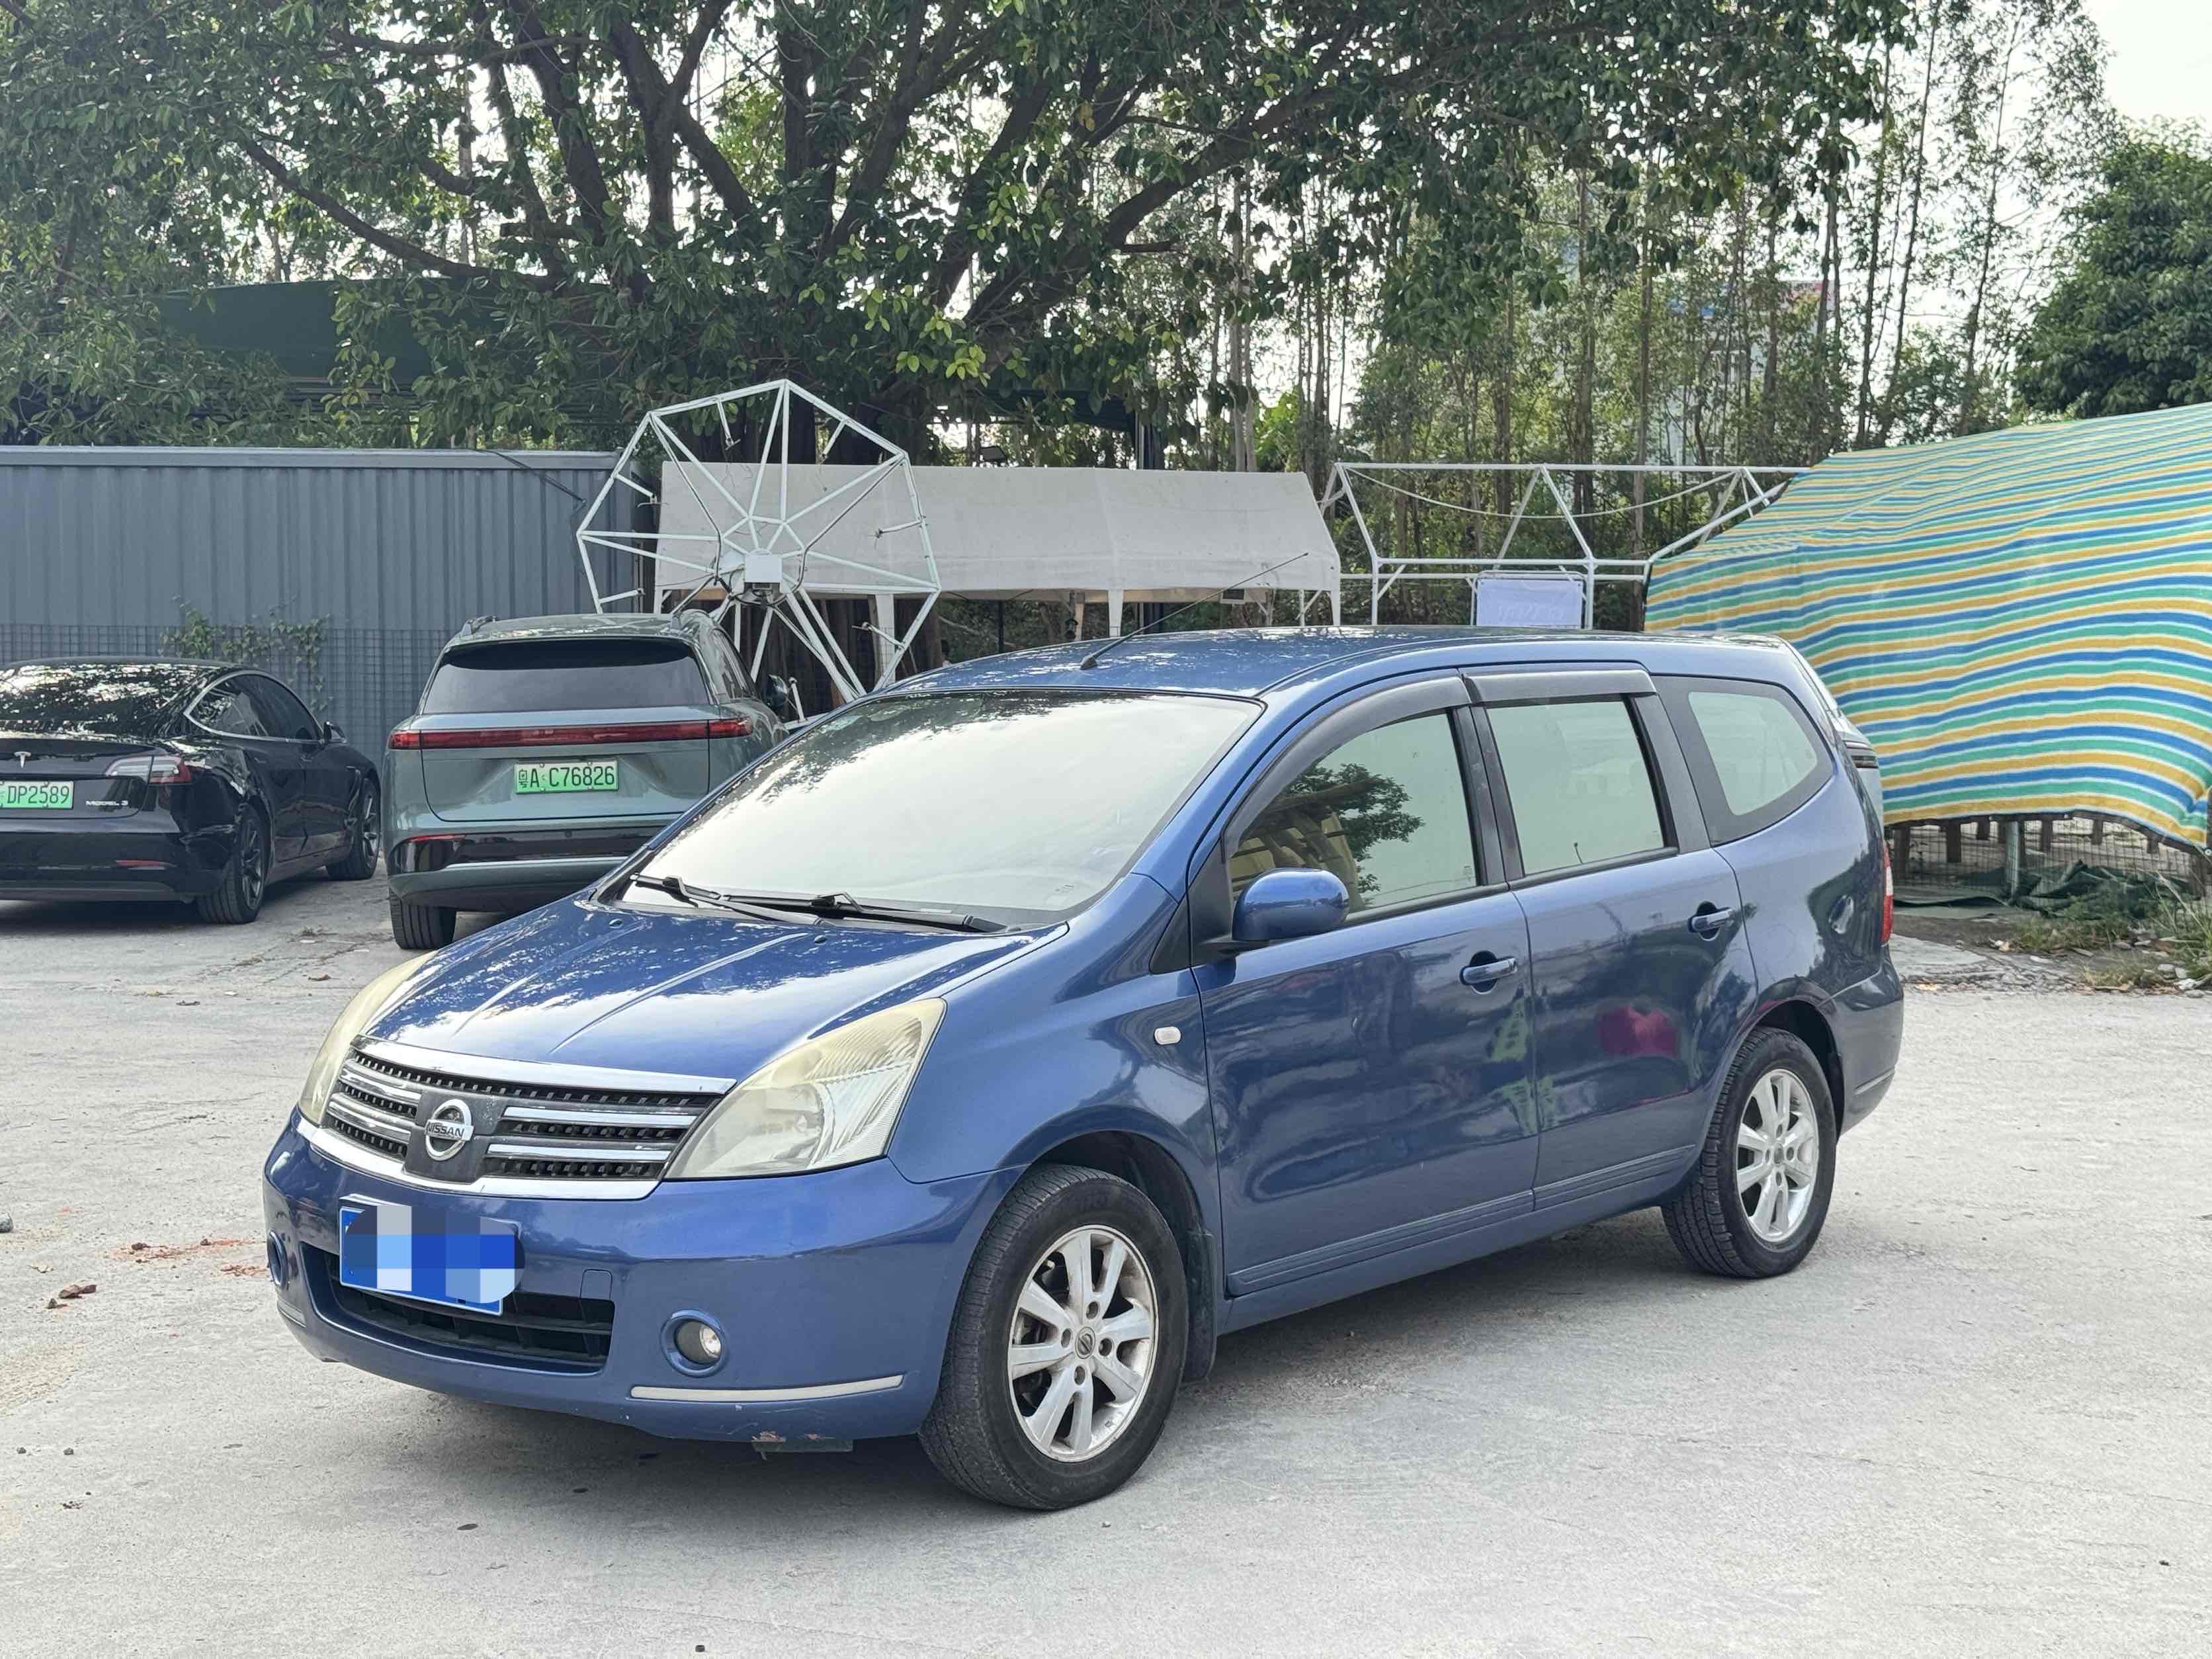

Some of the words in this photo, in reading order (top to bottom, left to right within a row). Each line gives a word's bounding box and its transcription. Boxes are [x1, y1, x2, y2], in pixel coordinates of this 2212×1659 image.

[549, 765, 615, 787] C76826
[7, 785, 69, 804] DP2589
[427, 1120, 465, 1138] NISSAN
